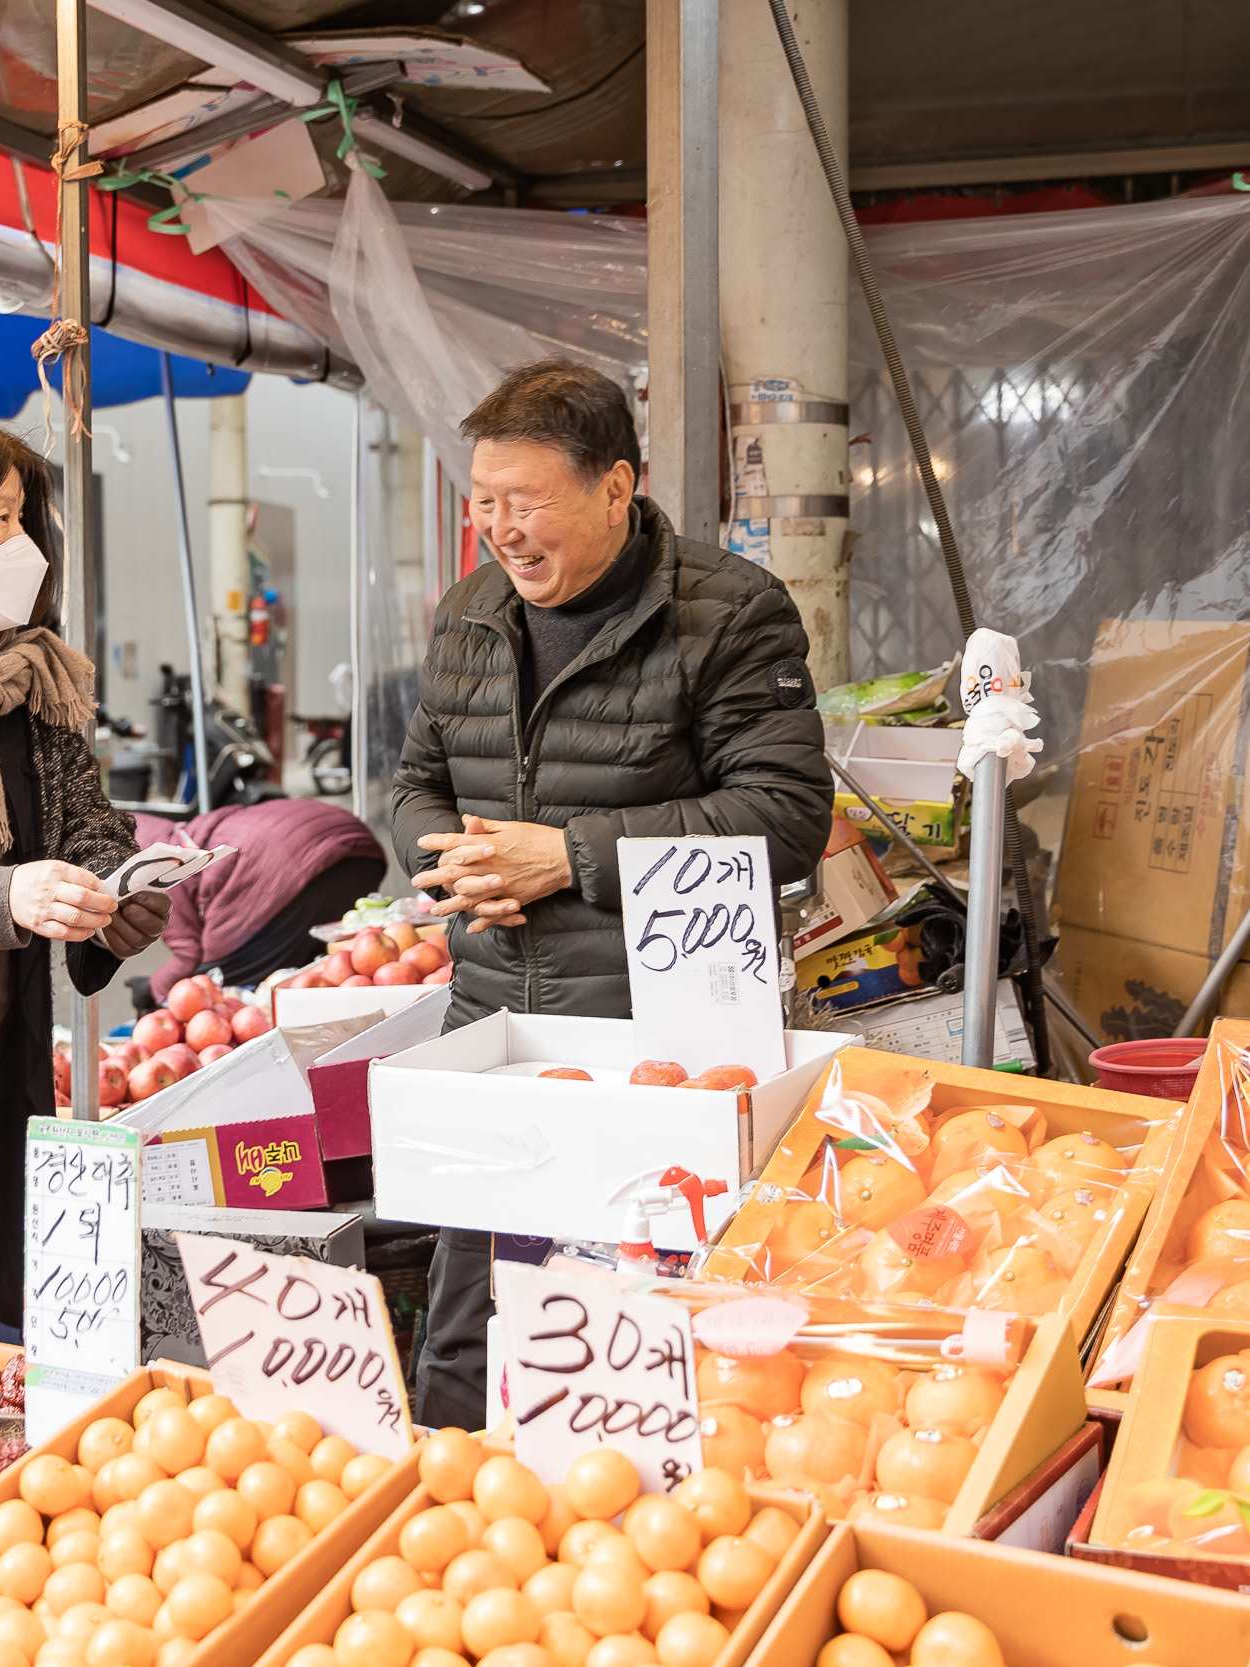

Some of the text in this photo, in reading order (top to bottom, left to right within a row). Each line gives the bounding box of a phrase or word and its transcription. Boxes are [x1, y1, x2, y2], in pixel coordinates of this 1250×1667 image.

[633, 845, 754, 896] 10개
[52, 1126, 73, 1137] 원산지
[907, 1207, 947, 1257] 제주명품
[200, 1251, 372, 1328] 40개
[518, 1294, 689, 1400] 30개
